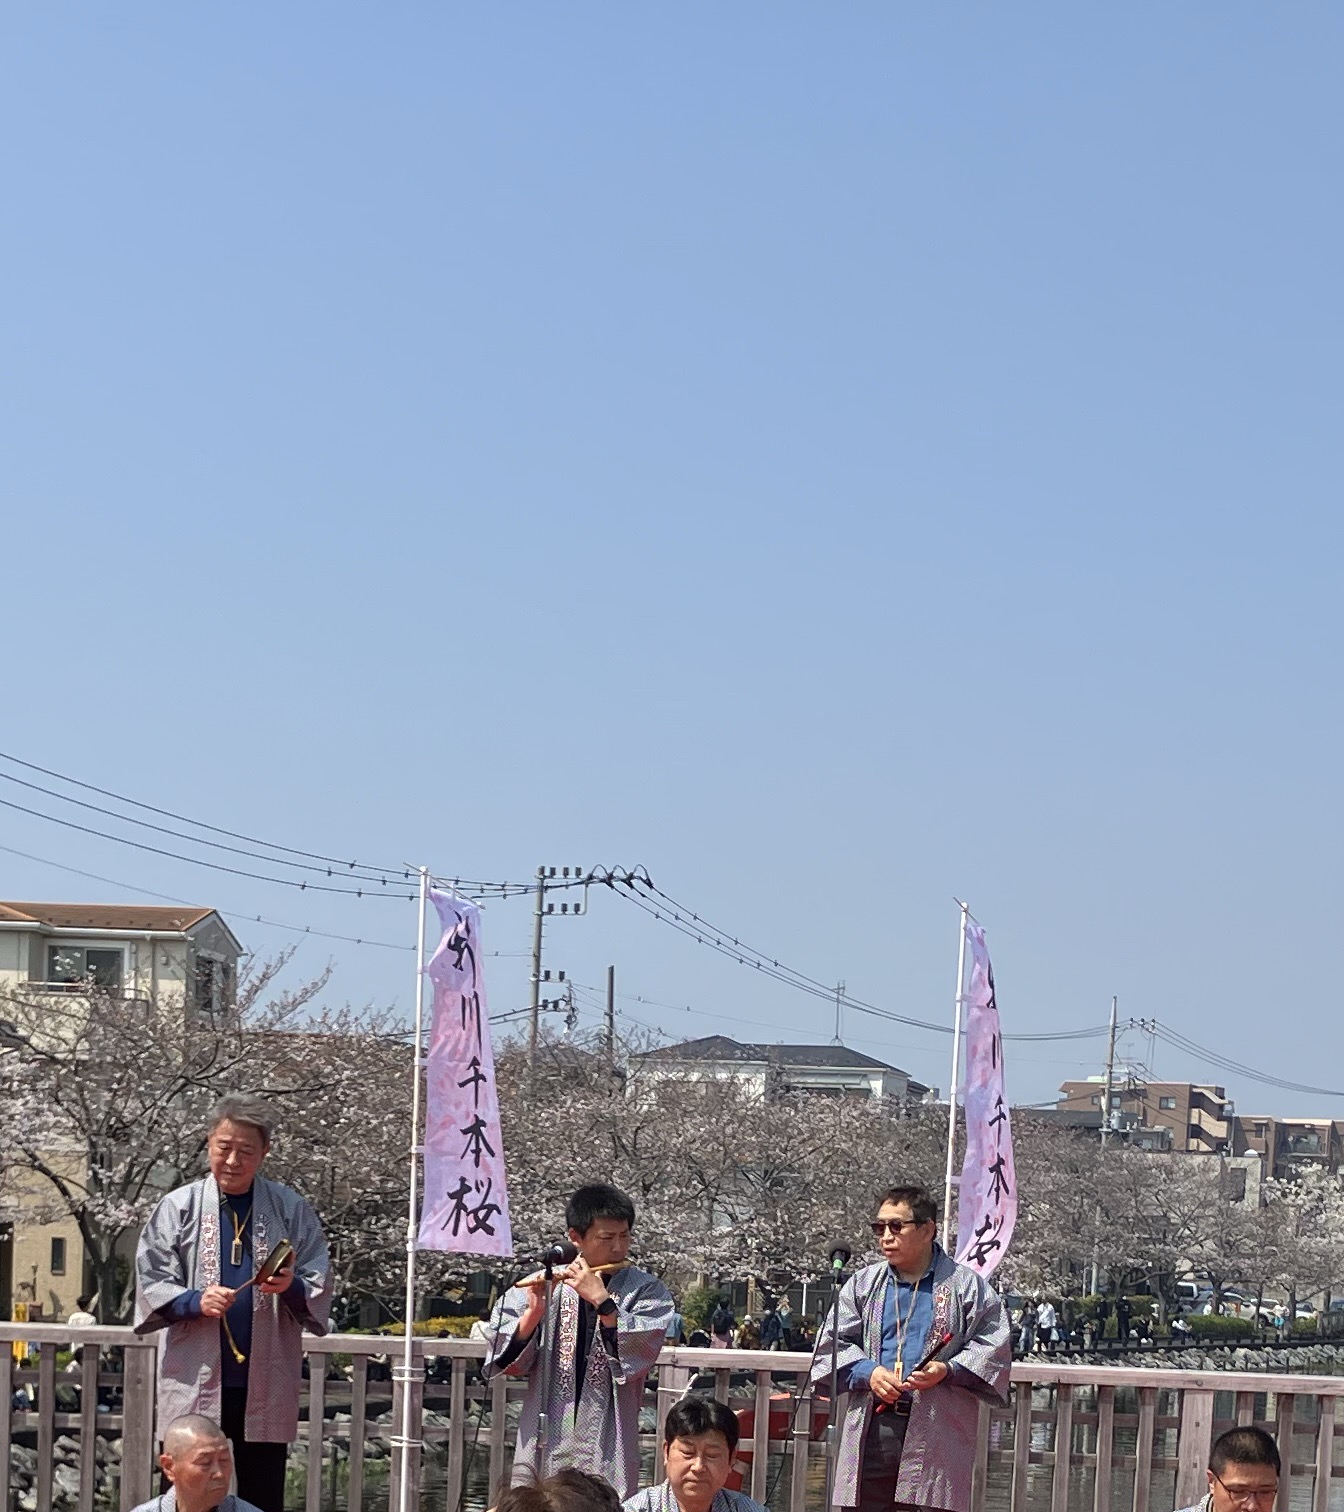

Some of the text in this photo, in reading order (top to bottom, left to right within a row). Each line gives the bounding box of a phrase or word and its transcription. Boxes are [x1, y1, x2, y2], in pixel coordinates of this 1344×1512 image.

[441, 909, 502, 1237] 新川千本桜
